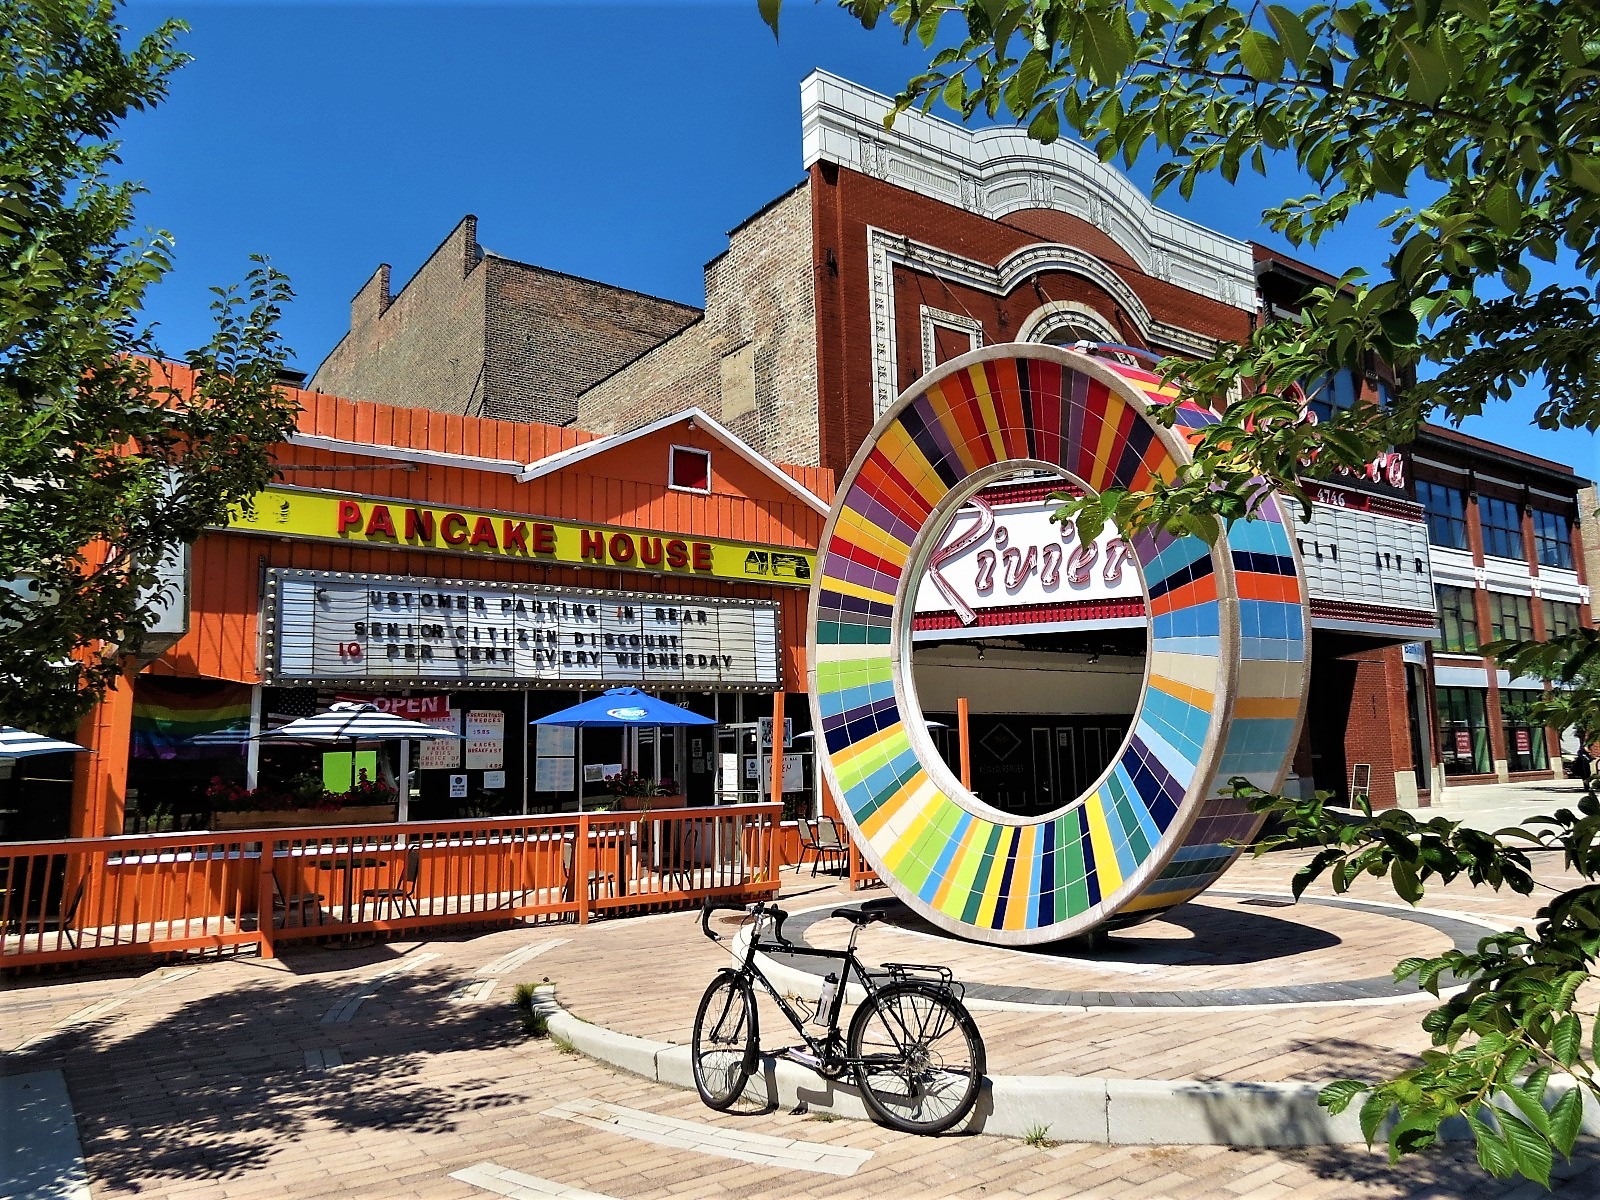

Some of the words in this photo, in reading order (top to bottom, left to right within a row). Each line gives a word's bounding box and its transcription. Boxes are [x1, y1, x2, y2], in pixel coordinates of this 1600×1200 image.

[1317, 488, 1346, 507] 4746
[337, 501, 555, 553] PANCAKE
[581, 529, 713, 570] HOUSE
[501, 599, 596, 618] PARKING
[617, 606, 633, 619] IN
[655, 607, 707, 623] REAR
[354, 621, 444, 639] SENIOR
[456, 625, 557, 643] CITIZEN
[574, 632, 679, 649] DISCOUNT
[339, 642, 362, 657] 10
[387, 643, 434, 659] PER
[456, 645, 511, 662] CENT
[533, 649, 600, 664] EVERY
[616, 652, 733, 668] WEDNESDAY
[372, 697, 439, 713] OPEN
